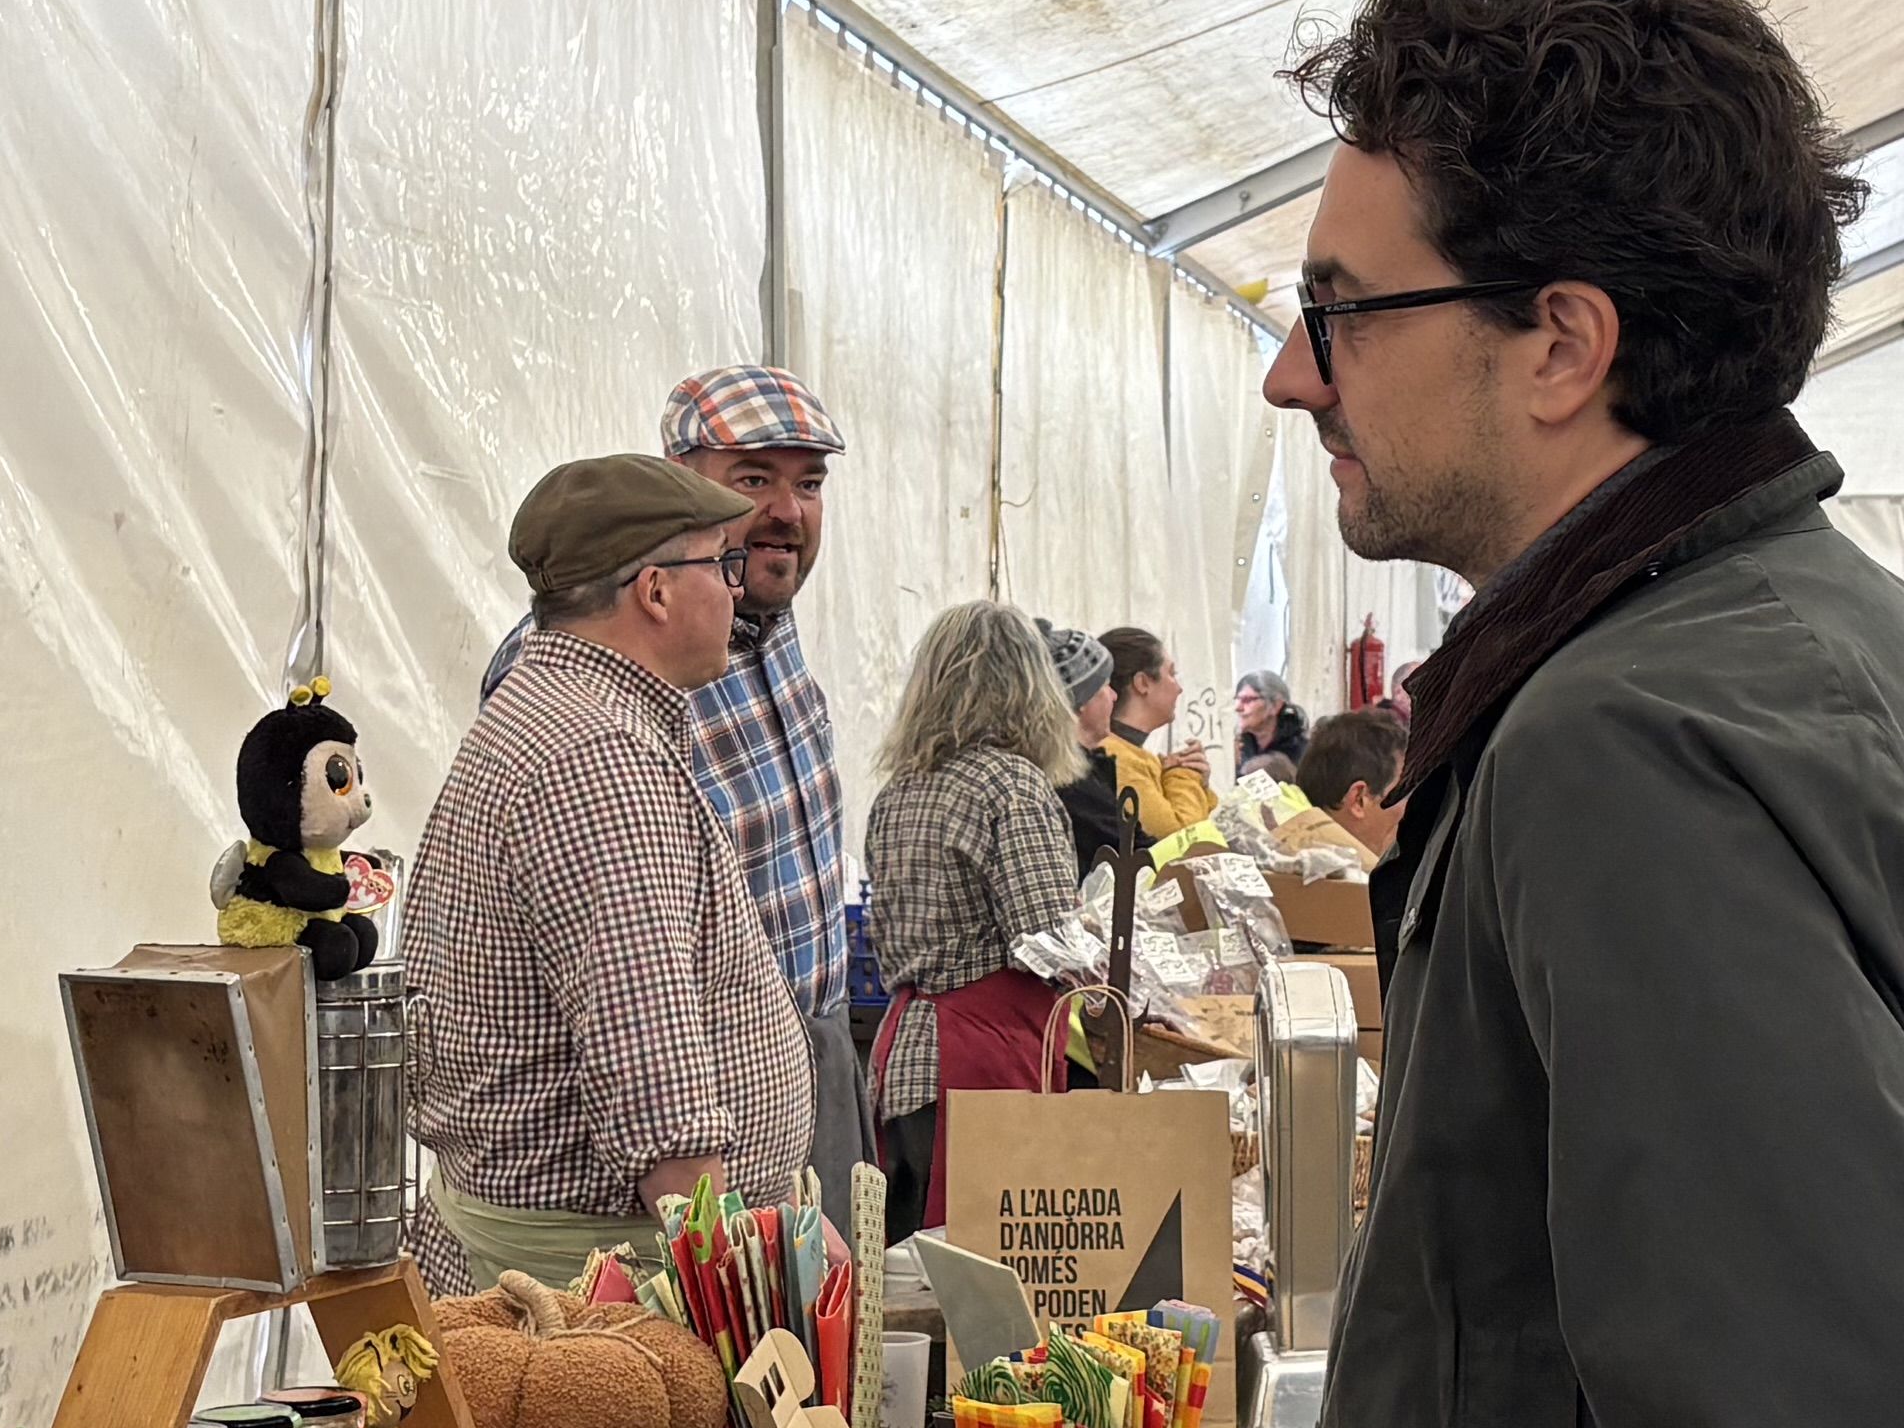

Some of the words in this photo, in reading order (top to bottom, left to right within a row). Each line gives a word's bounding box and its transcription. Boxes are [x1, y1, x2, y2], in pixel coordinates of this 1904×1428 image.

[999, 1188, 1014, 1218] A
[1020, 1187, 1122, 1222] L'ALÇADA
[999, 1221, 1125, 1251] D'ANDORRA
[1033, 1289, 1107, 1319] PODEN
